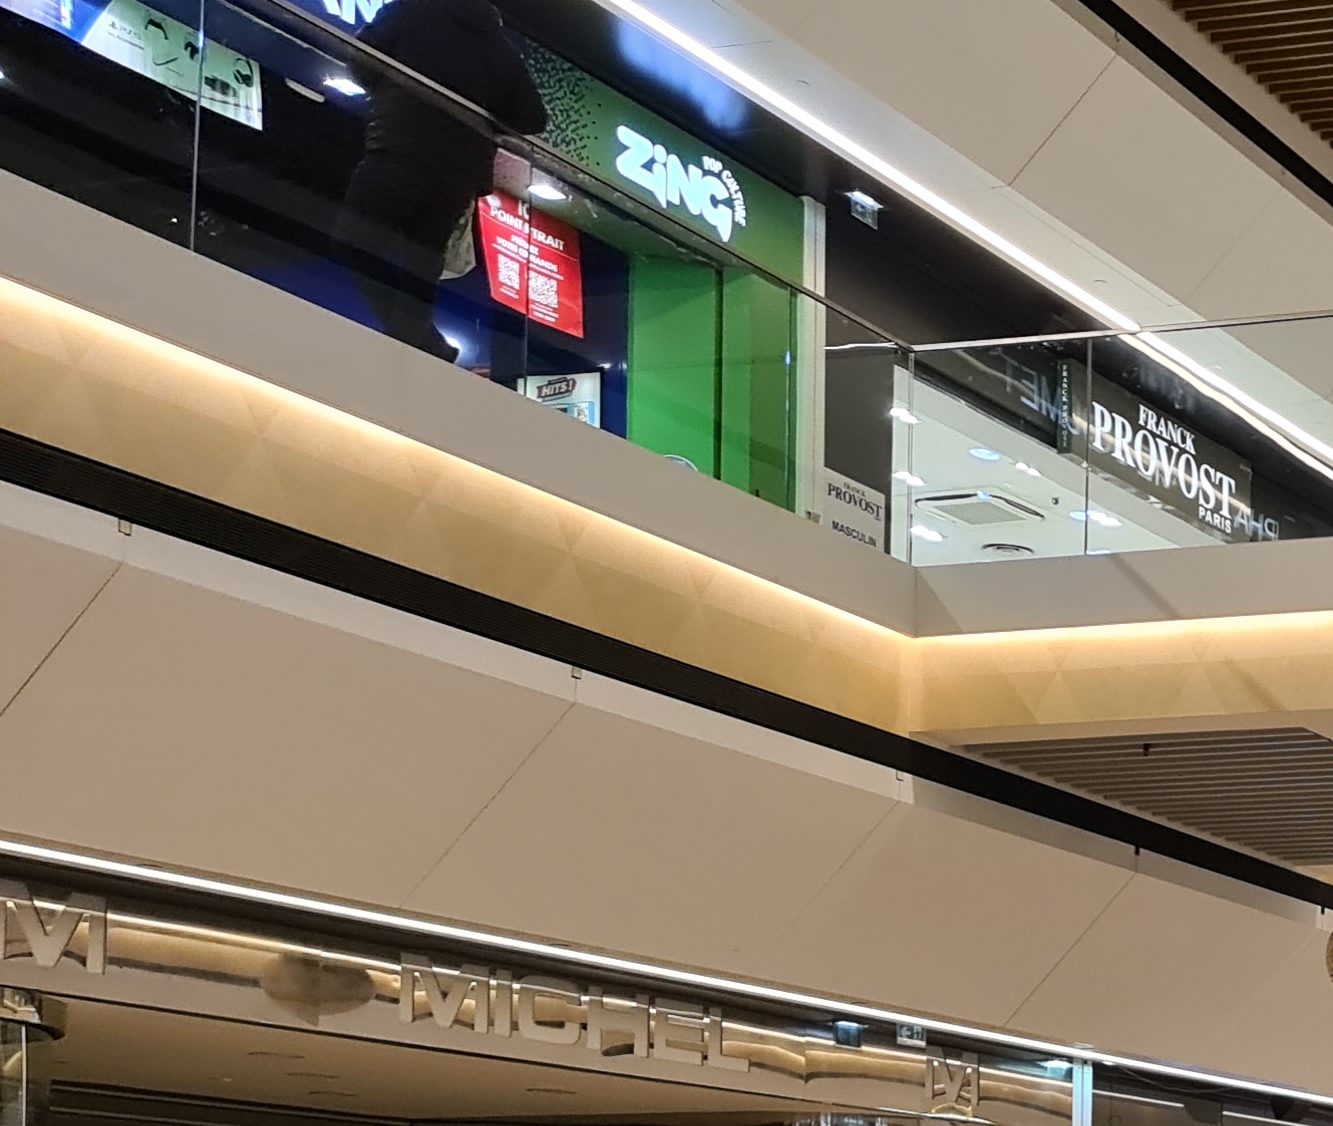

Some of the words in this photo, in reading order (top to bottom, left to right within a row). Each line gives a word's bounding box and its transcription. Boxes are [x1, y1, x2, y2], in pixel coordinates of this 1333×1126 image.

[702, 156, 723, 173] POP
[721, 170, 747, 227] CULTURE
[490, 206, 524, 230] POINT
[541, 382, 567, 397] HITS
[1138, 403, 1196, 455] FRANCK
[1091, 401, 1236, 519] PROVOST
[827, 482, 883, 517] PROVOST
[831, 519, 877, 548] MASCULIN
[1198, 505, 1232, 534] PARIS
[400, 953, 750, 1073] MICHEL
